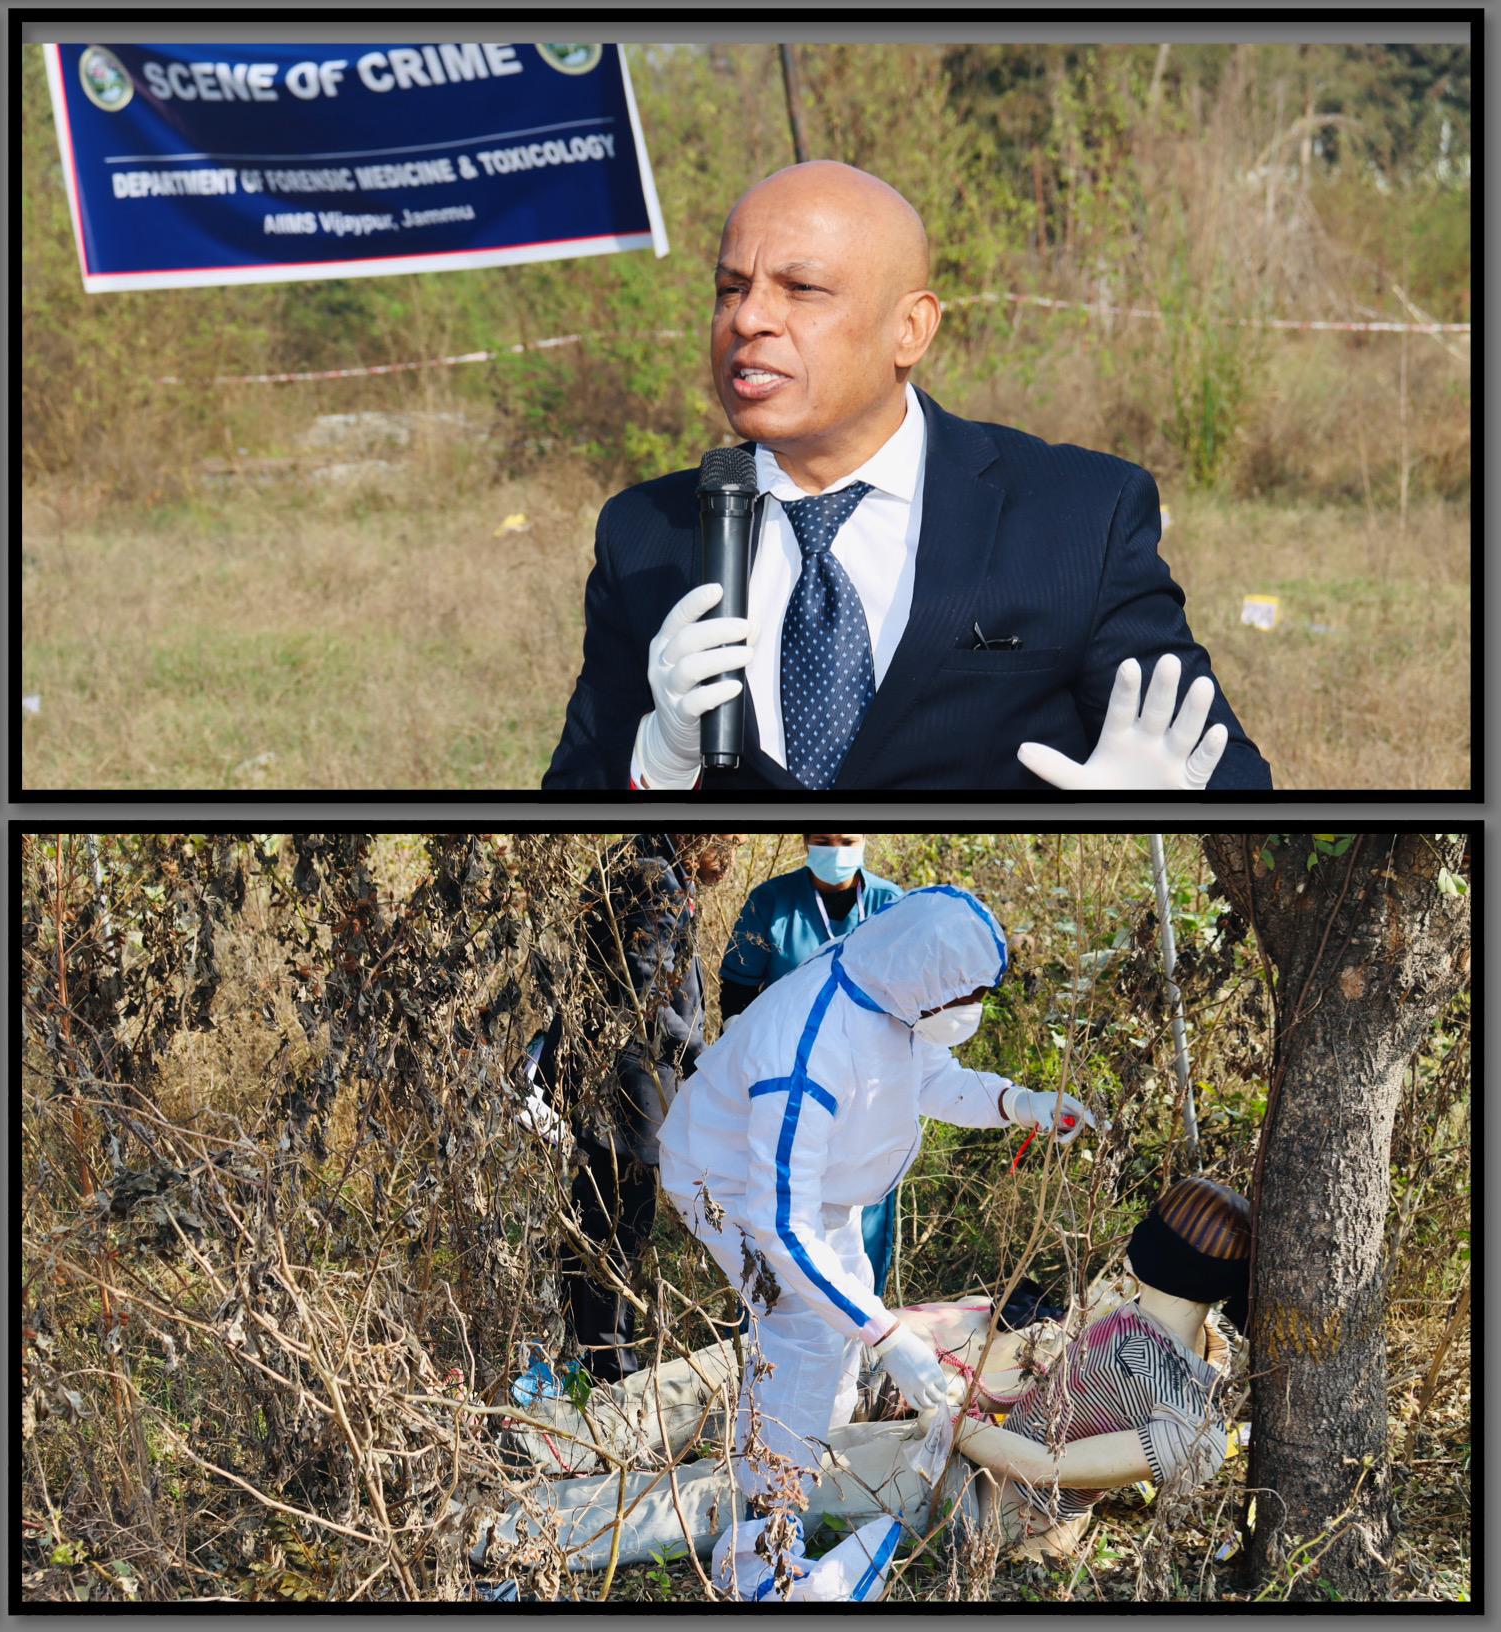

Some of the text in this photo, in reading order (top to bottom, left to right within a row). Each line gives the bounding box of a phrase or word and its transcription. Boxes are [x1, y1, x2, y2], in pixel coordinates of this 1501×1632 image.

[142, 62, 279, 101] SCENE
[286, 59, 348, 100] OF
[357, 43, 524, 93] CRIME
[111, 133, 616, 199] DEPARTMENT OF FORENSIC MEDICINE & TOXICOLOGY
[263, 204, 476, 237] AIIMS Vijaypur, Jammu
